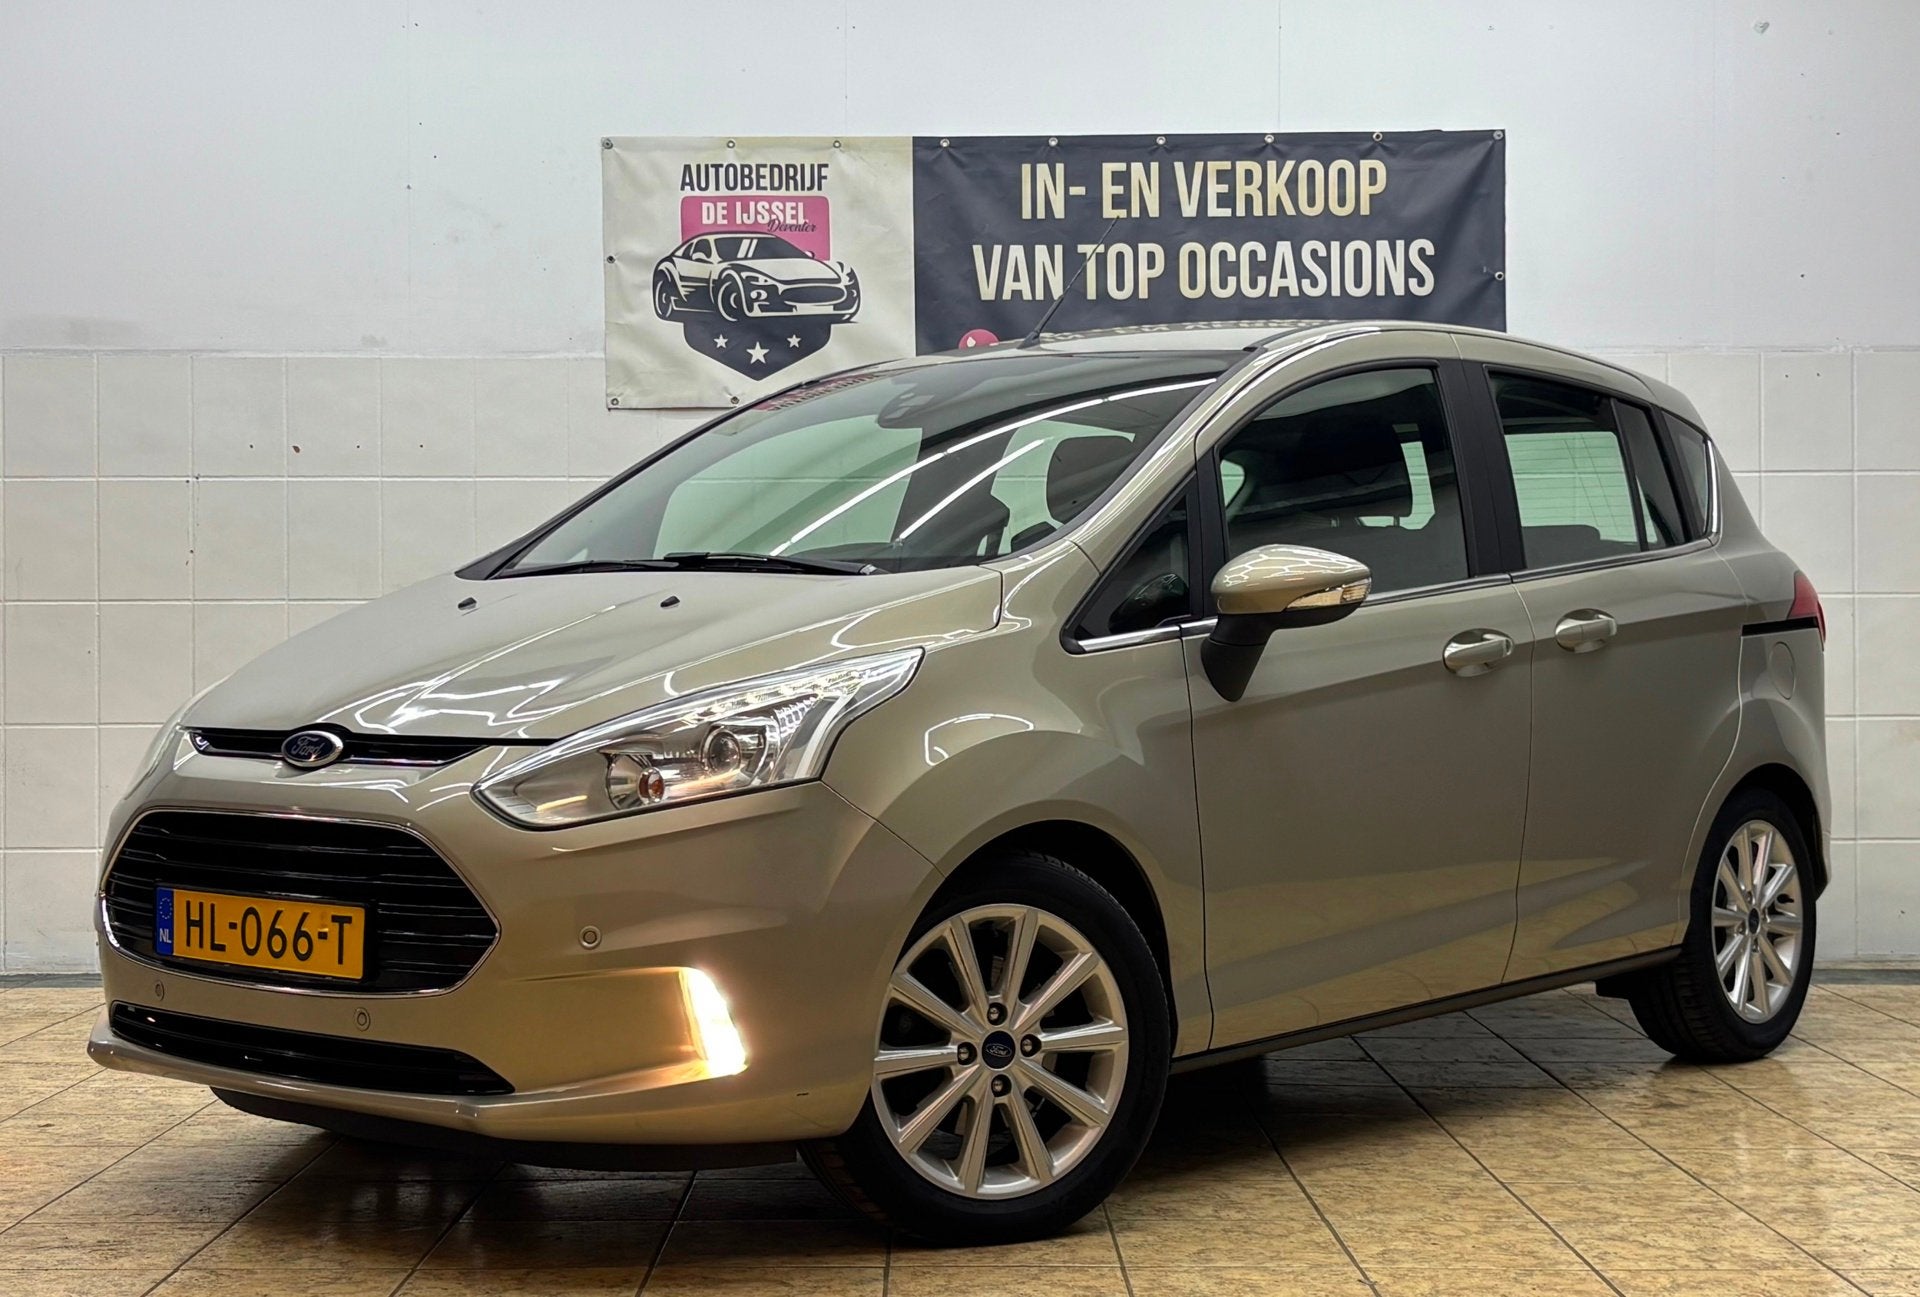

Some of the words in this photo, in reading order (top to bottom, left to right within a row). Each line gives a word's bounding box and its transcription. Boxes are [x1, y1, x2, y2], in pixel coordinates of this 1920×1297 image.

[680, 163, 829, 191] AUTOBEDRIJF
[1021, 162, 1086, 219] IN-
[1102, 161, 1160, 218] EN
[1174, 159, 1387, 218] VERKOOP
[702, 202, 728, 224] DE
[735, 201, 809, 224] IJSSEL
[767, 218, 817, 233] Deventer
[972, 243, 1063, 301] VAN
[1077, 243, 1165, 300] TOP
[1179, 239, 1435, 298] OCCASIONS
[290, 736, 326, 756] Ford
[159, 928, 172, 944] NL
[185, 900, 353, 966] HL-066-T
